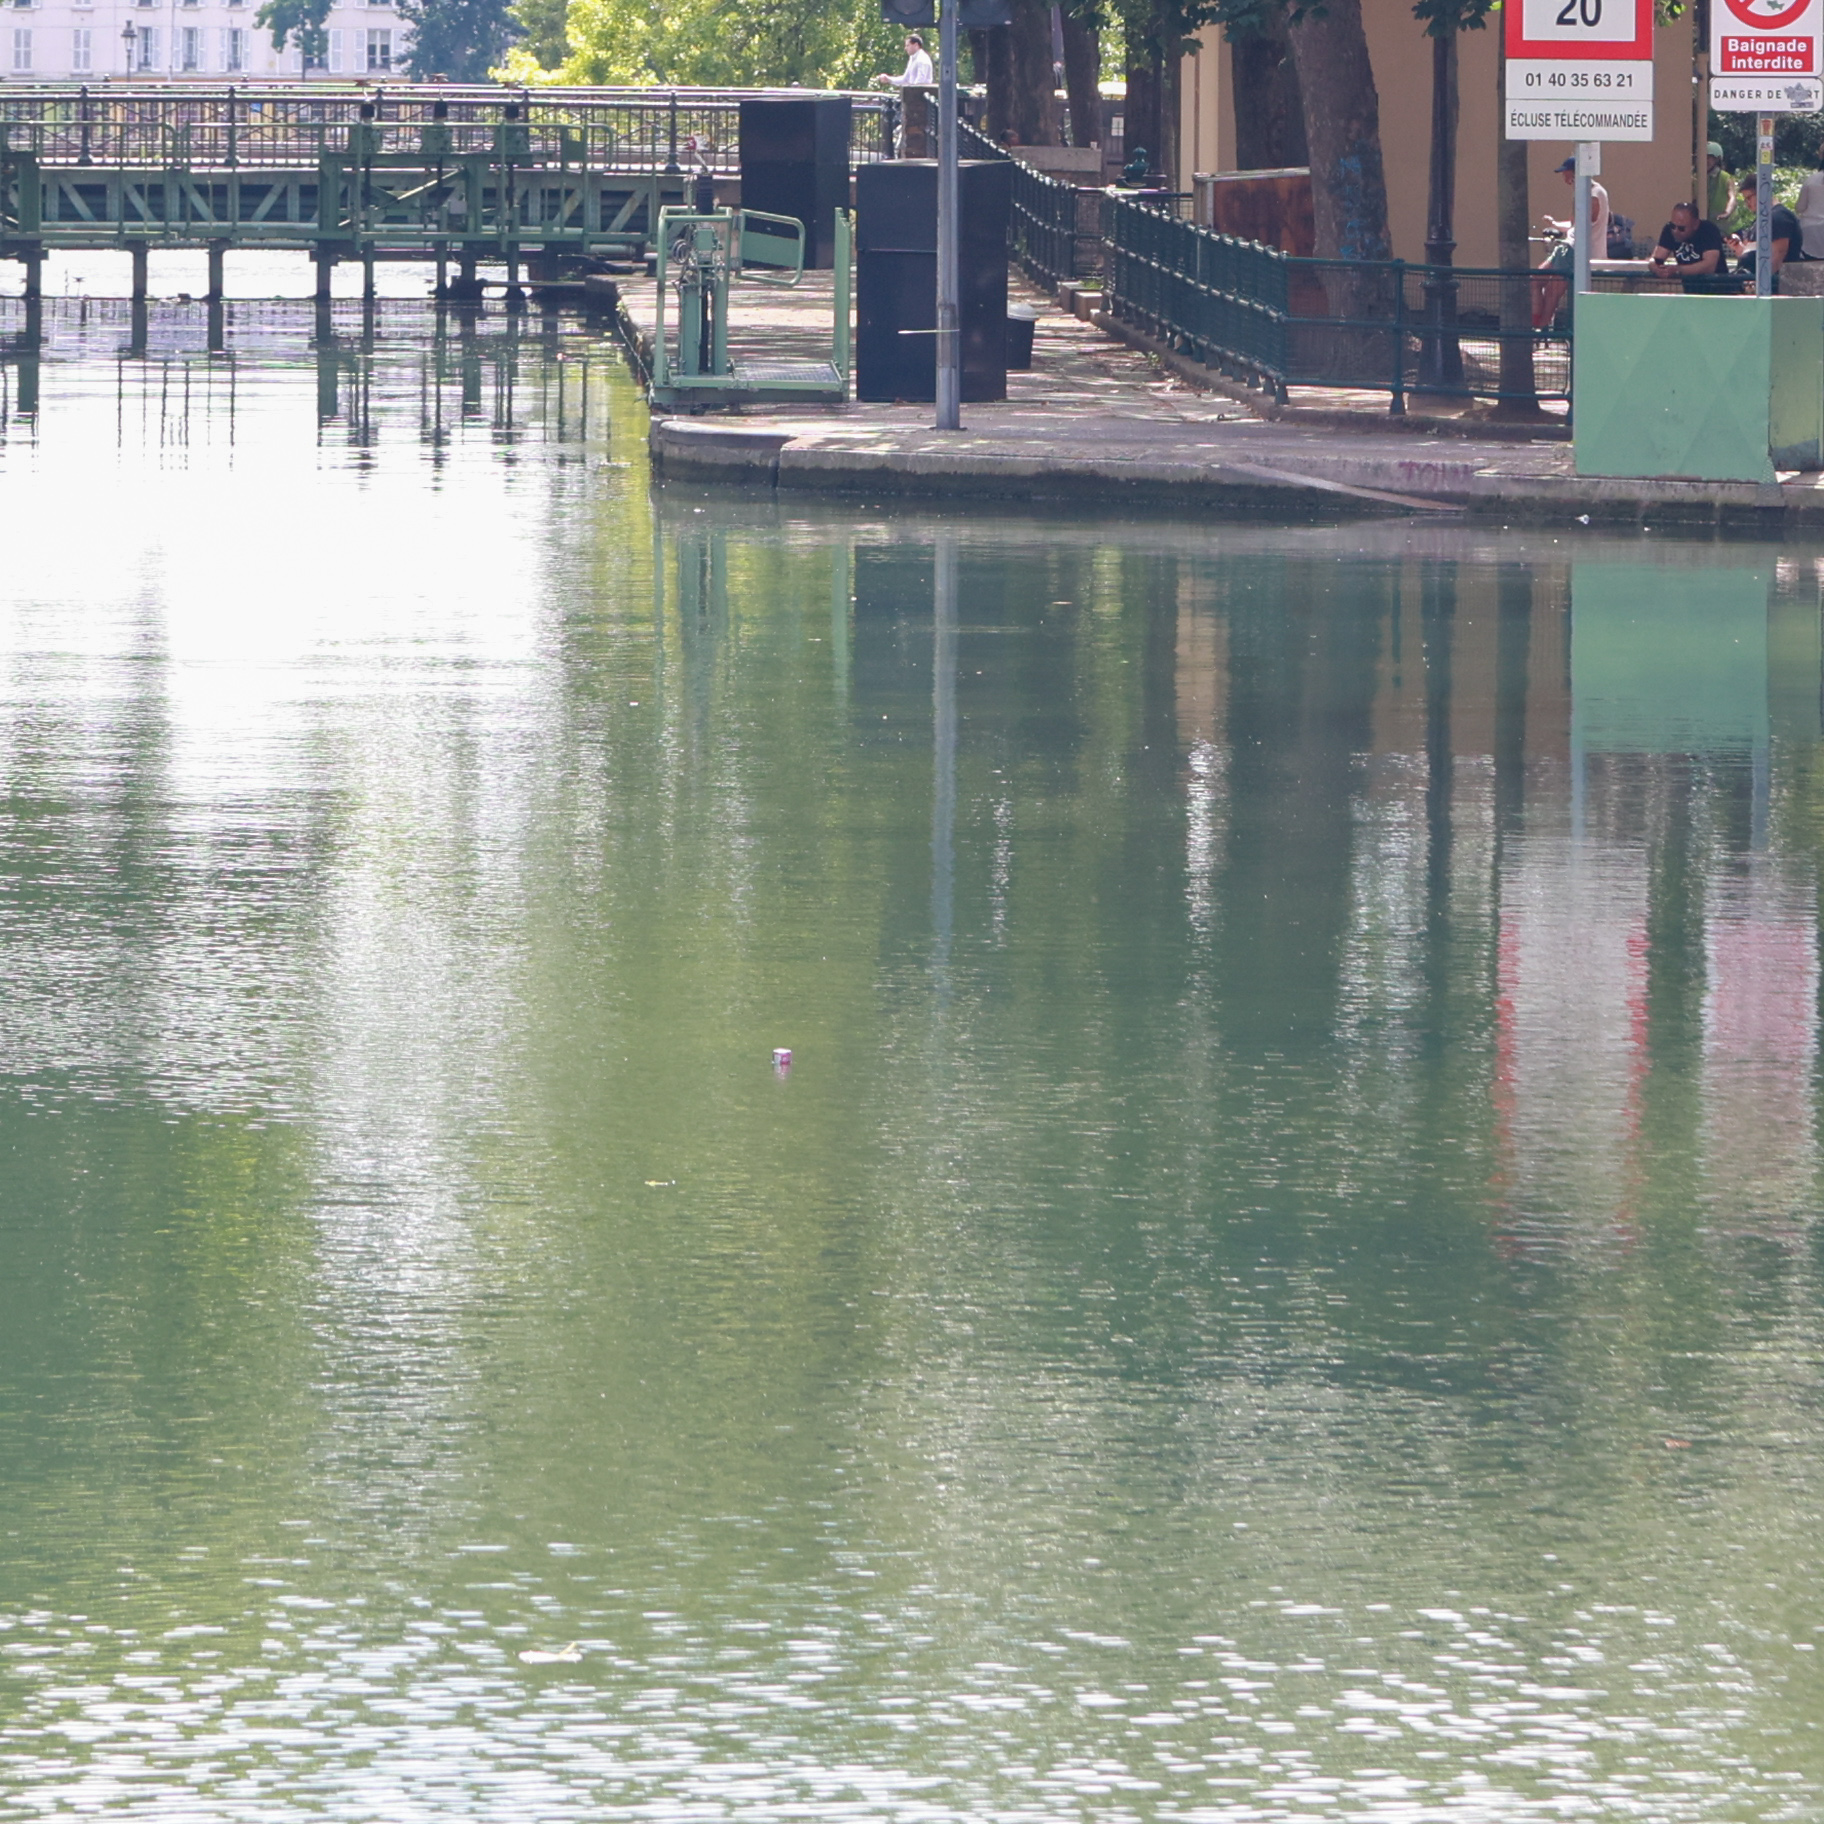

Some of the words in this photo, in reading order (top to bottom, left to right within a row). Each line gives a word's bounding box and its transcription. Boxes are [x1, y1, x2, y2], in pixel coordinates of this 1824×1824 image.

[1728, 38, 1807, 55] Baignade
[1731, 56, 1803, 69] interdite
[1525, 72, 1542, 87] 01
[1548, 72, 1566, 87] 40
[1570, 73, 1589, 87] 35
[1593, 73, 1612, 87] 63
[1616, 73, 1633, 87] 21
[1714, 89, 1762, 99] DANGER
[1767, 89, 1782, 99] DE
[1510, 109, 1551, 127] ÉCLUSE
[1554, 109, 1648, 128] TÉLÉCOMMANDÉE
